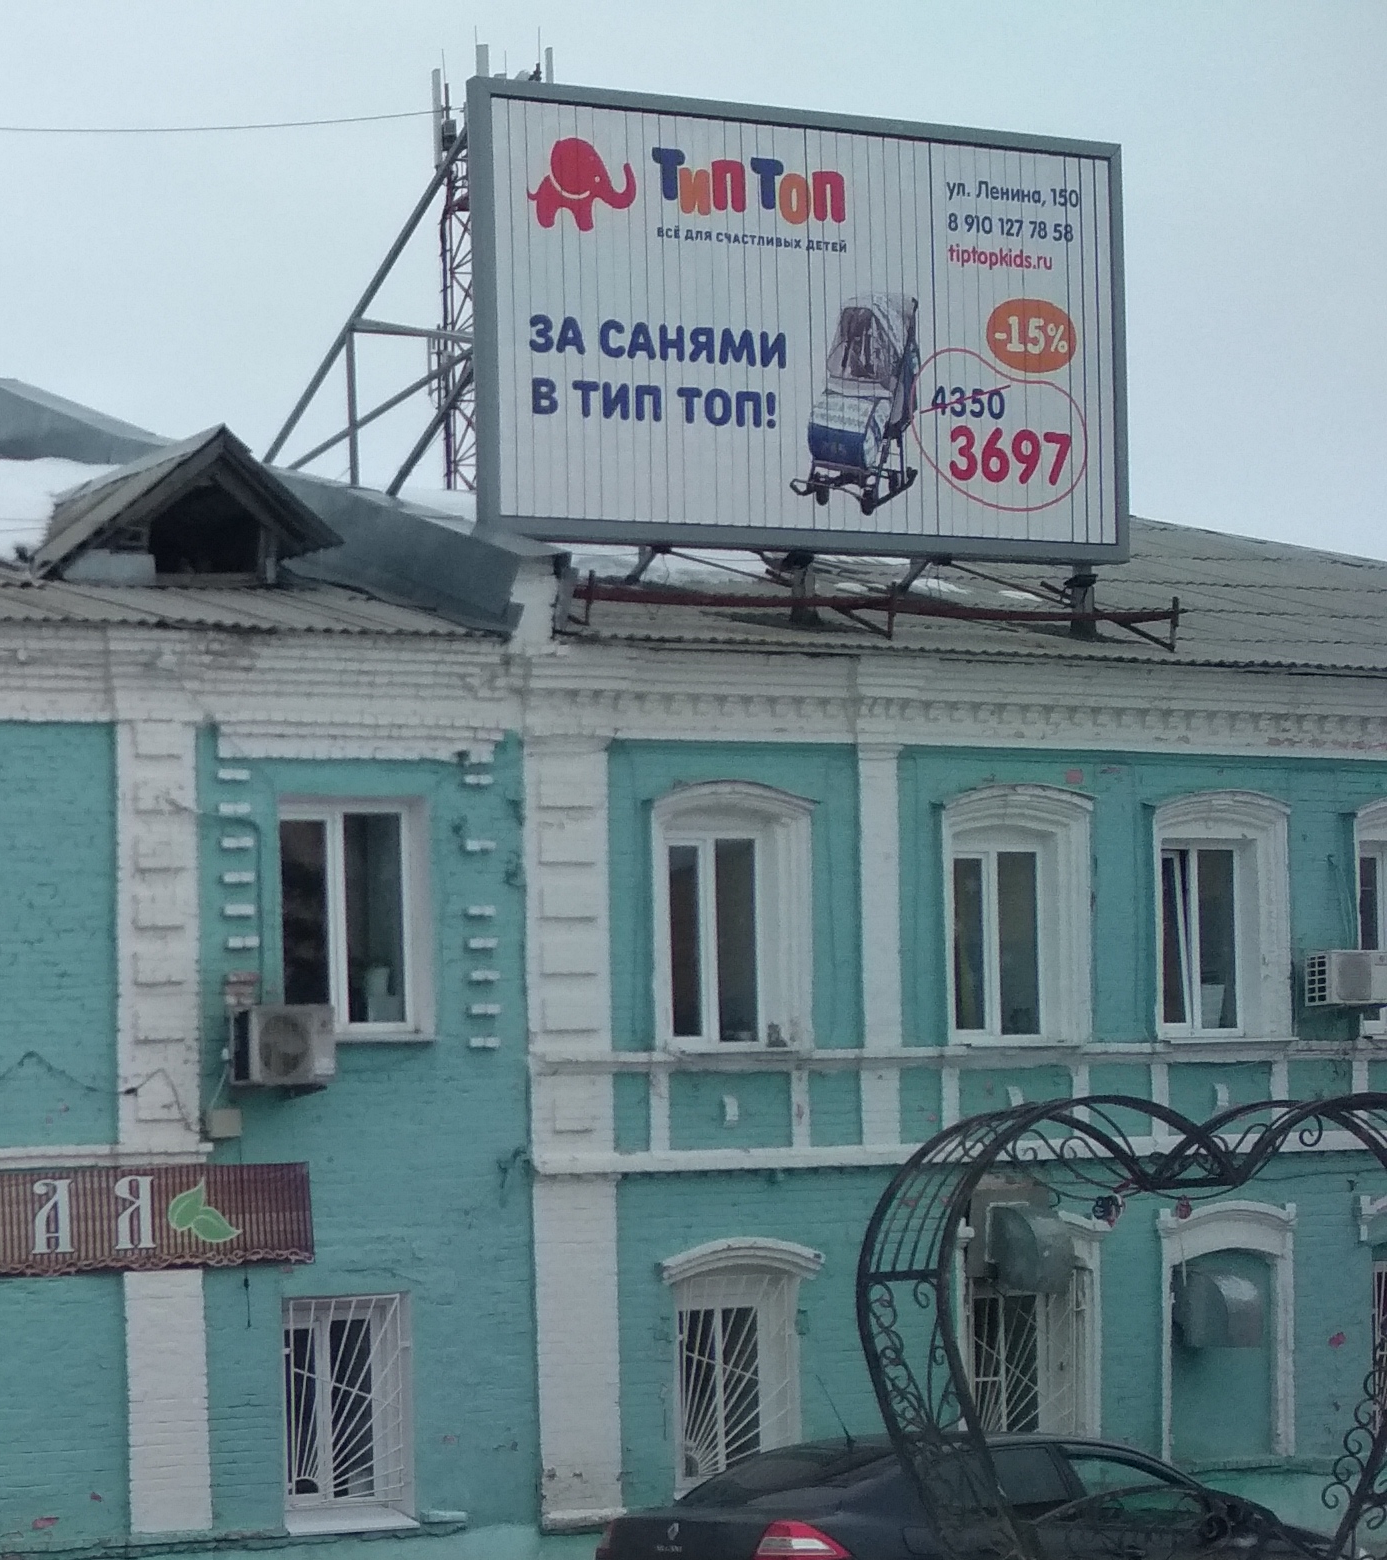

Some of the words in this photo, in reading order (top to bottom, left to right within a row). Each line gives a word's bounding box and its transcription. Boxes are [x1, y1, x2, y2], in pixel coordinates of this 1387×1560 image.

[946, 181, 971, 201] ул.
[977, 180, 1047, 208] Ленина,
[1050, 188, 1080, 208] 150
[656, 225, 680, 240] ВСЁ
[684, 229, 713, 242] ДЛЯ
[715, 231, 802, 250] СЧАСТЛИВЫХ
[805, 237, 848, 253] ДЕТЕЙ
[947, 212, 959, 232] 8
[964, 213, 993, 235] 910
[998, 217, 1024, 238] 127
[1029, 220, 1048, 240] 78
[1052, 223, 1074, 243] 58
[948, 243, 1053, 271] tiptopkids.ru
[529, 313, 586, 355] ЗА
[599, 318, 787, 369] САНЯМИ
[994, 315, 1068, 355] -15%
[531, 376, 559, 416] В
[572, 379, 663, 423] ТИП
[677, 386, 777, 430] ТОП!
[931, 385, 1006, 420] 4350
[949, 424, 1072, 487] 3697
